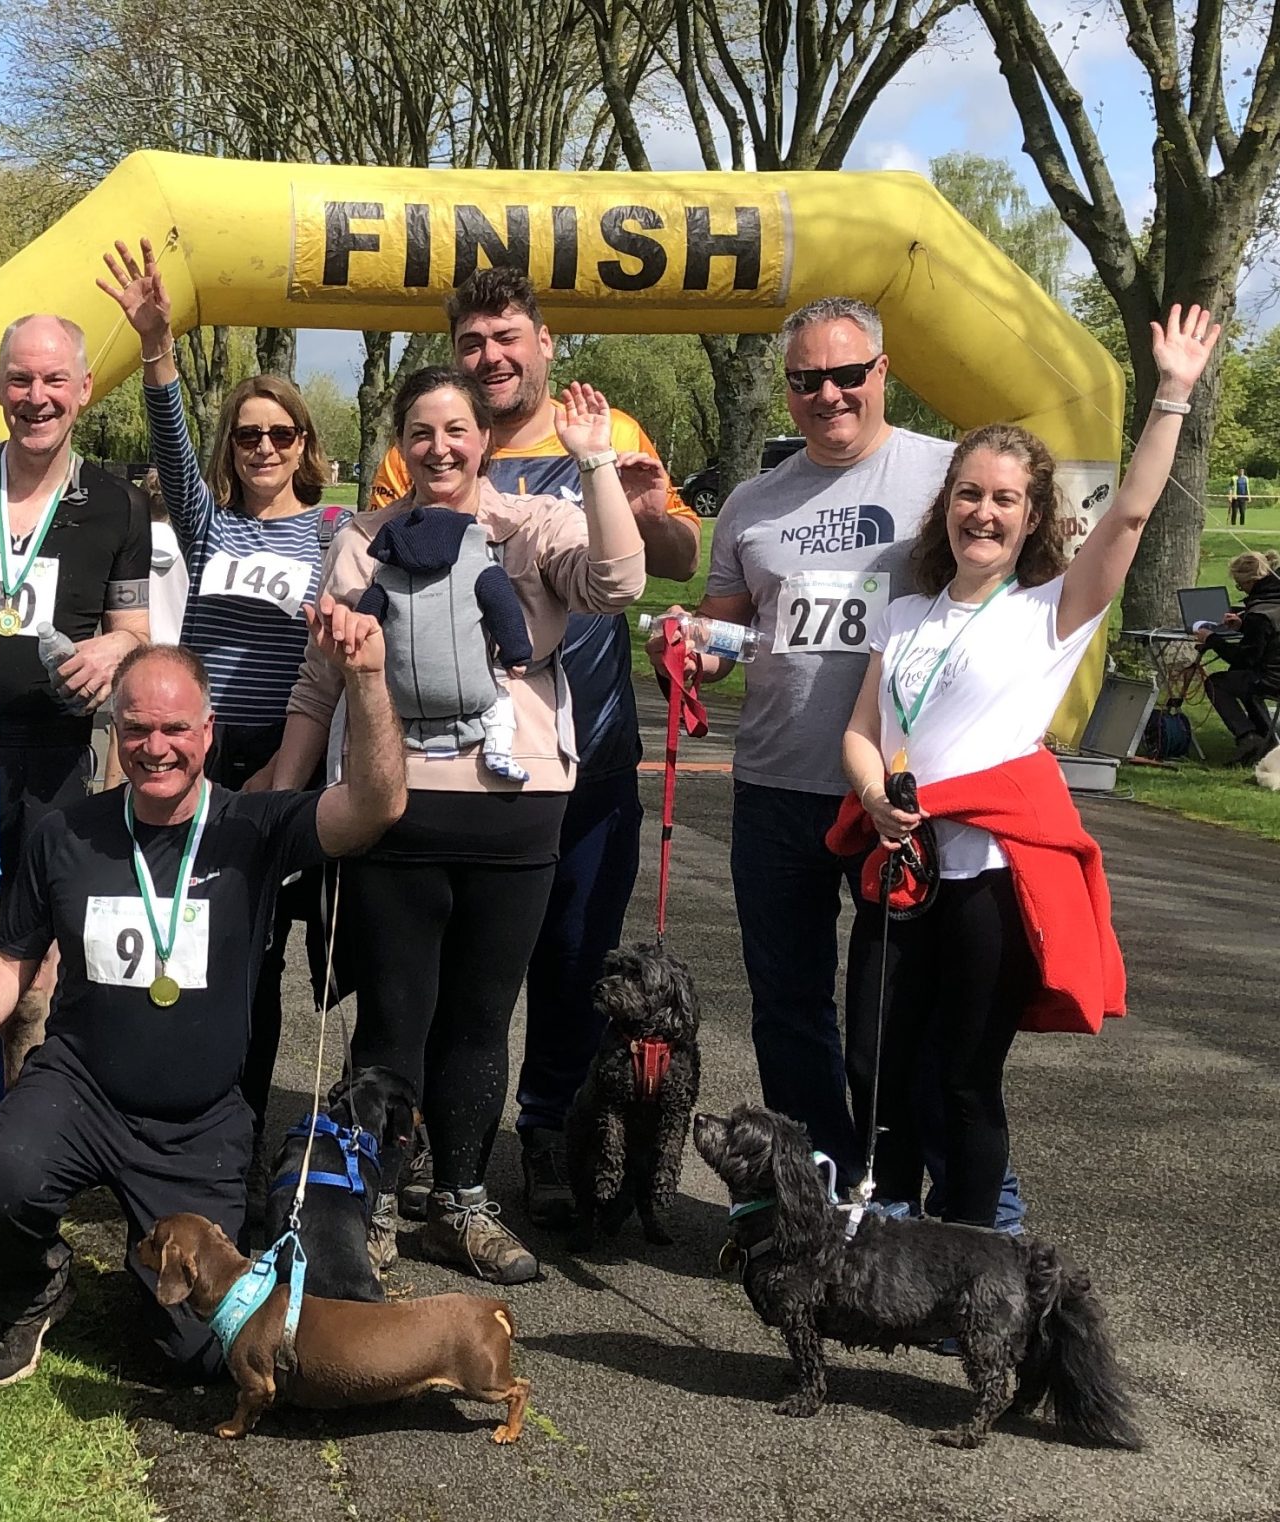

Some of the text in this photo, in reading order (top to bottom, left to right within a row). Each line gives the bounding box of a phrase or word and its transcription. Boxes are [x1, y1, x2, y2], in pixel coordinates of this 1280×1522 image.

[322, 200, 762, 291] FINISH
[816, 505, 858, 525] THE
[780, 520, 856, 544] NORTH
[799, 535, 855, 556] FACE
[224, 560, 290, 601] 146
[788, 597, 867, 647] 278
